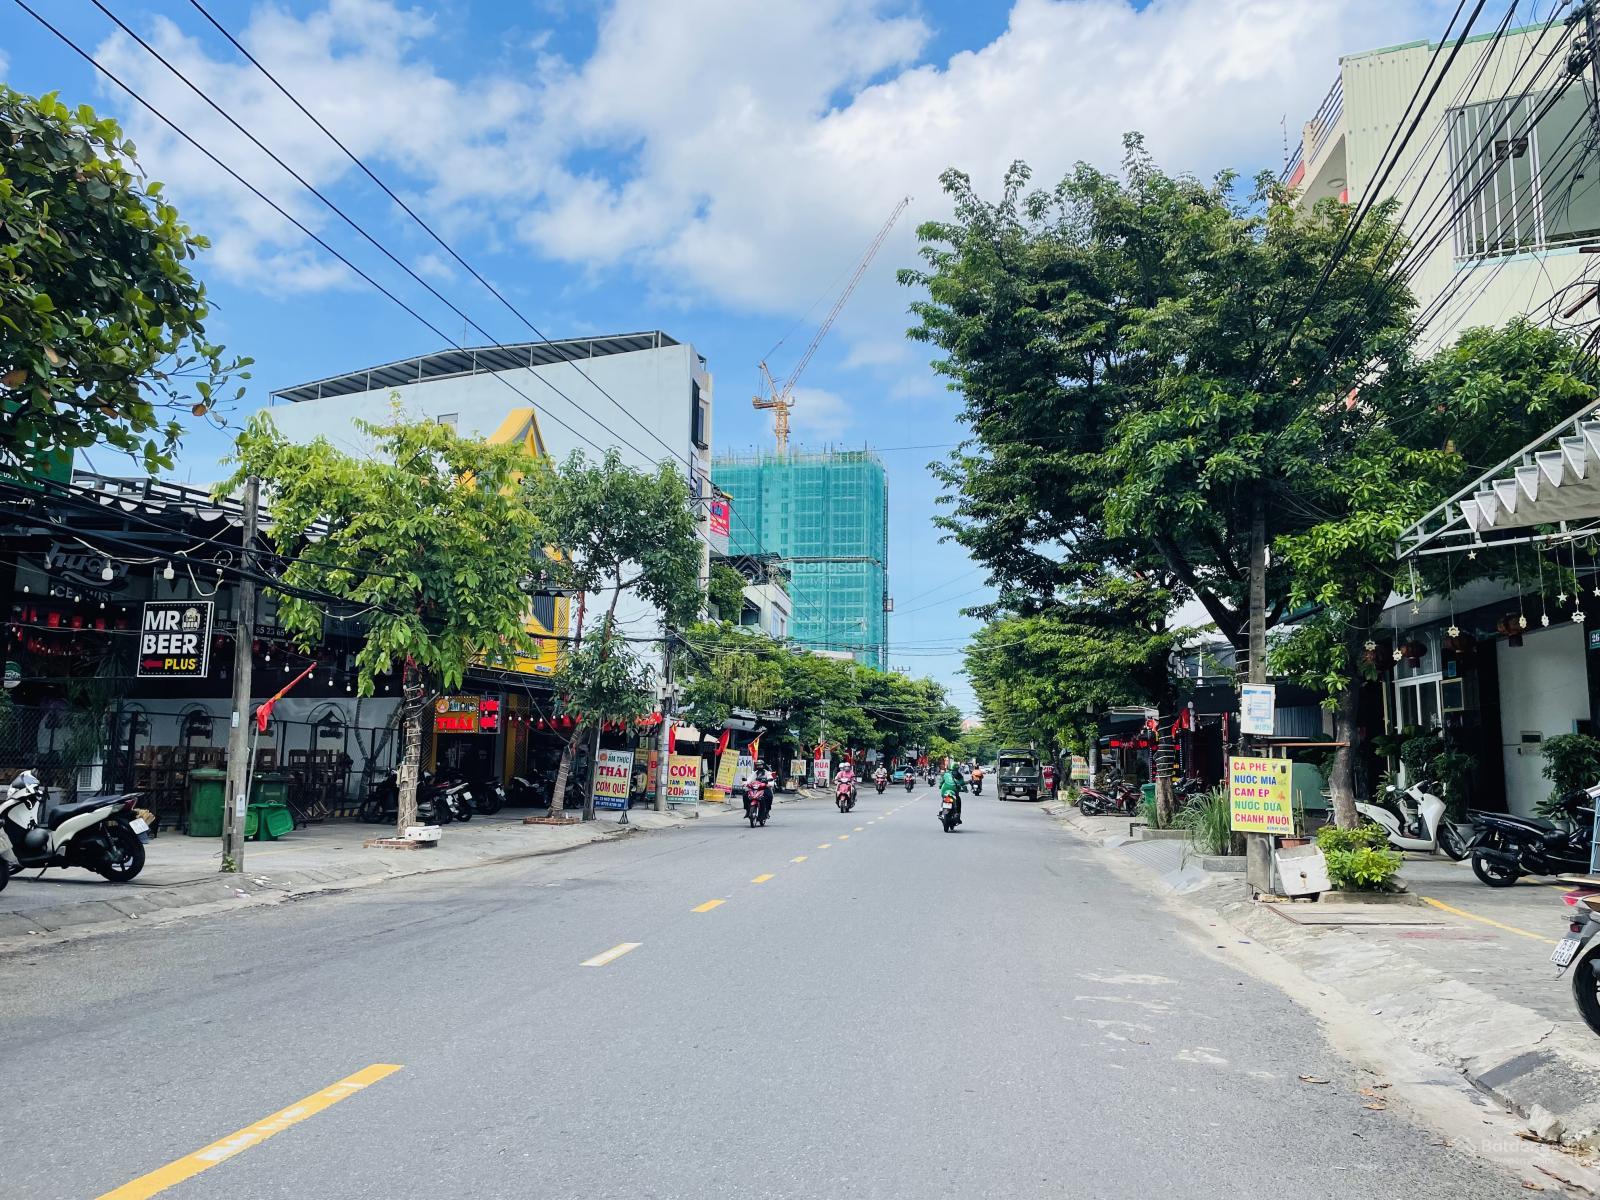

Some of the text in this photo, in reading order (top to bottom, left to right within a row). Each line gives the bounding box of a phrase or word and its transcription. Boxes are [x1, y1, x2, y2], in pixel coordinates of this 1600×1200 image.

[145, 610, 181, 631] MR
[142, 633, 199, 655] BEER
[164, 658, 197, 670] PLUS
[598, 764, 628, 778] THÁI
[1234, 788, 1255, 798] CAM
[1235, 813, 1264, 824] CHANH
